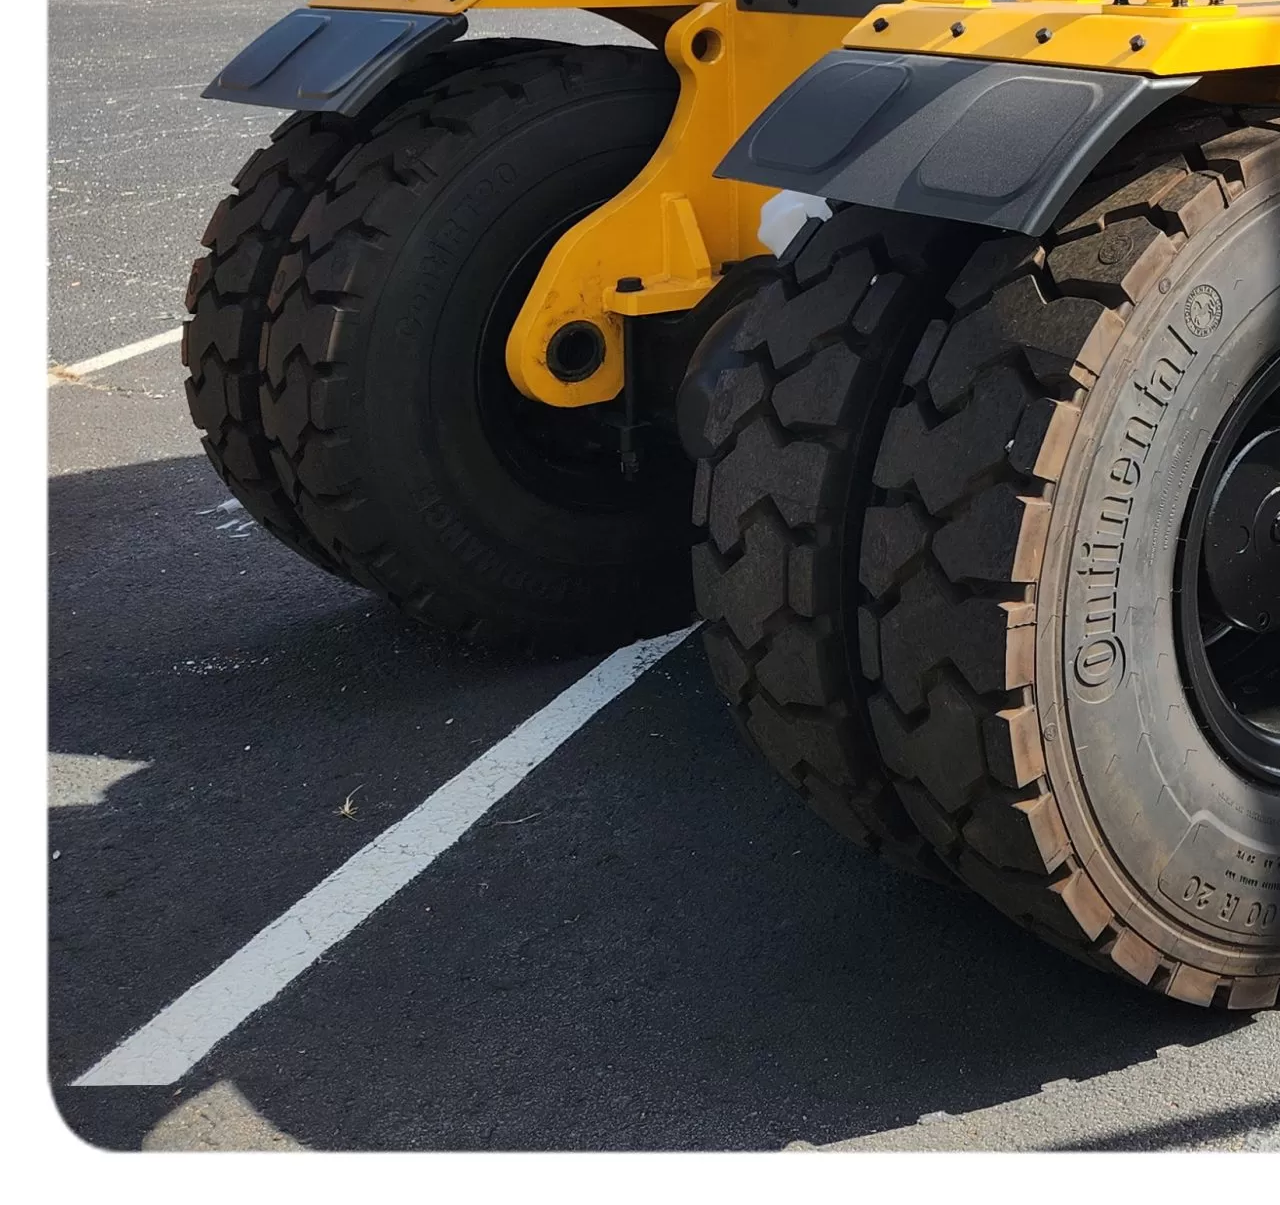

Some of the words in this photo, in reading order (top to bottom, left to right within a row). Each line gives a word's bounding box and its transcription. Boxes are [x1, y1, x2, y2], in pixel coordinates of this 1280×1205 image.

[1074, 323, 1197, 703] Continental
[1182, 875, 1216, 910] 20
[1217, 892, 1240, 923] R
